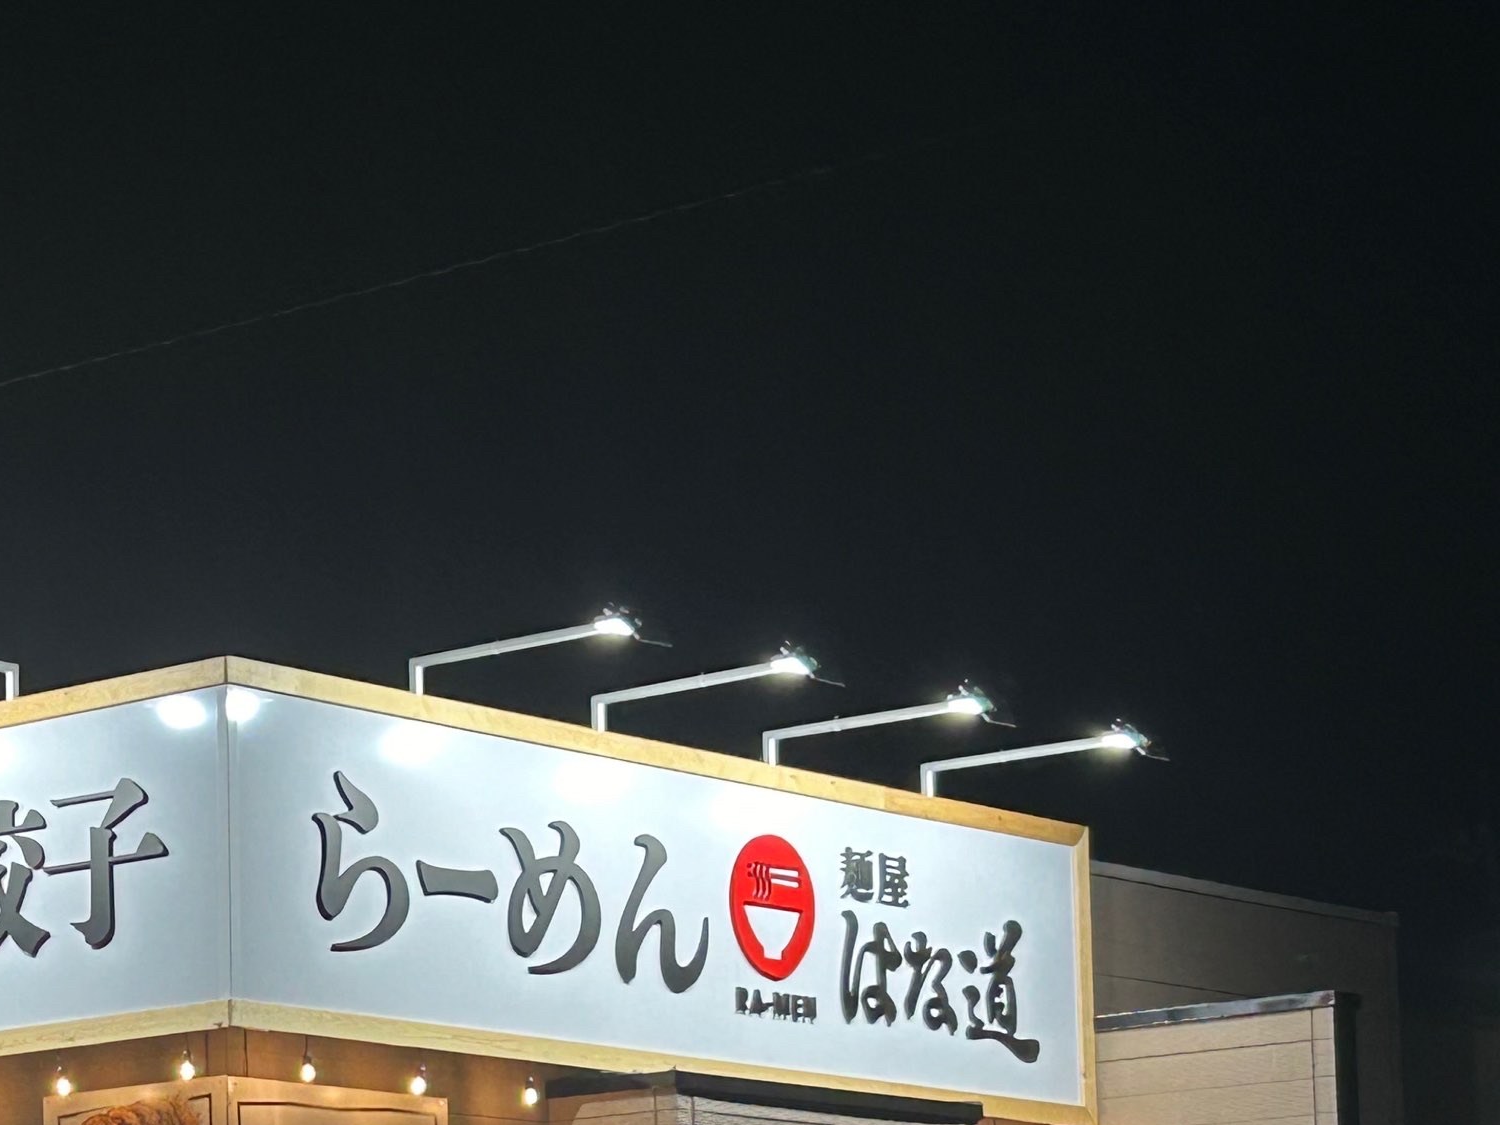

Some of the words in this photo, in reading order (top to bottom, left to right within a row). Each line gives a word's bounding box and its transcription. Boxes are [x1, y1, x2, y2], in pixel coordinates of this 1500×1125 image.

[312, 770, 708, 993] らーめん
[840, 847, 911, 908] 麺屋
[840, 910, 1040, 1063] はな道
